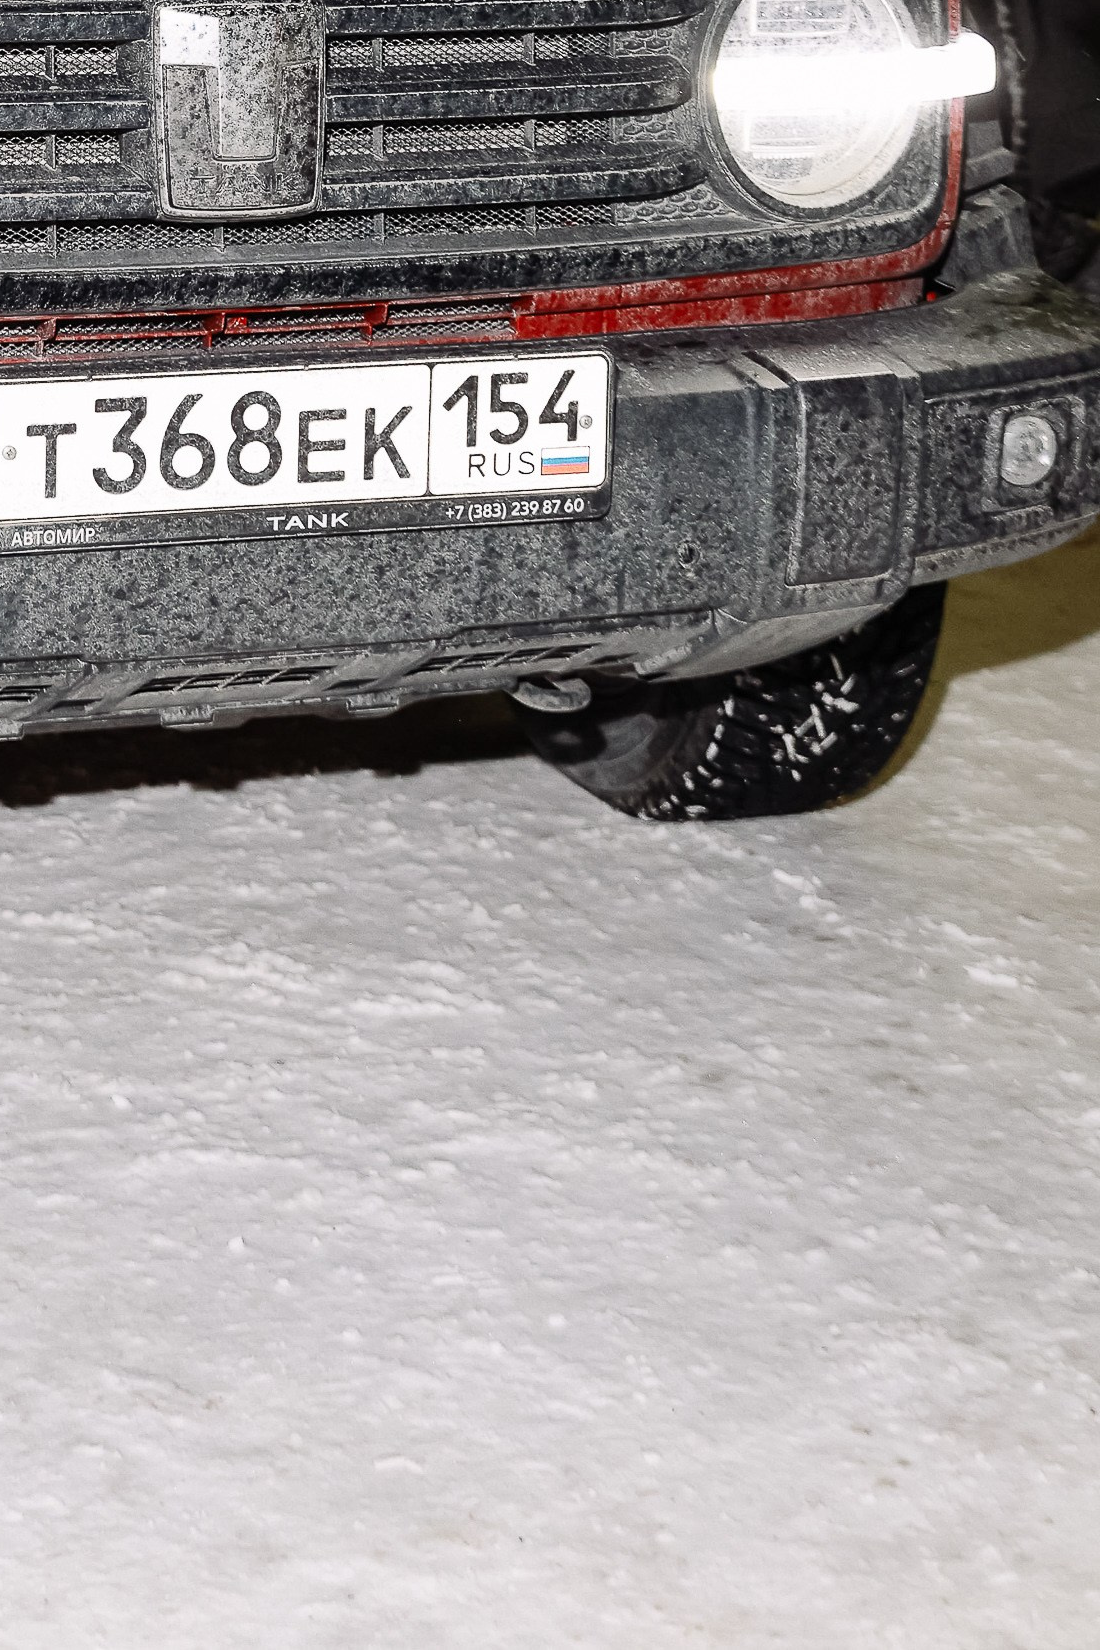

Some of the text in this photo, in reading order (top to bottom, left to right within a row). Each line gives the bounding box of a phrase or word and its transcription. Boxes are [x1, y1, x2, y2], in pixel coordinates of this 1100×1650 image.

[188, 172, 302, 195] TANK
[443, 369, 579, 447] 154
[468, 451, 535, 478] RUS
[266, 512, 349, 531] TANK
[445, 497, 585, 522] +7 (383) 239 87 60
[11, 527, 96, 547] АВТОМИР
